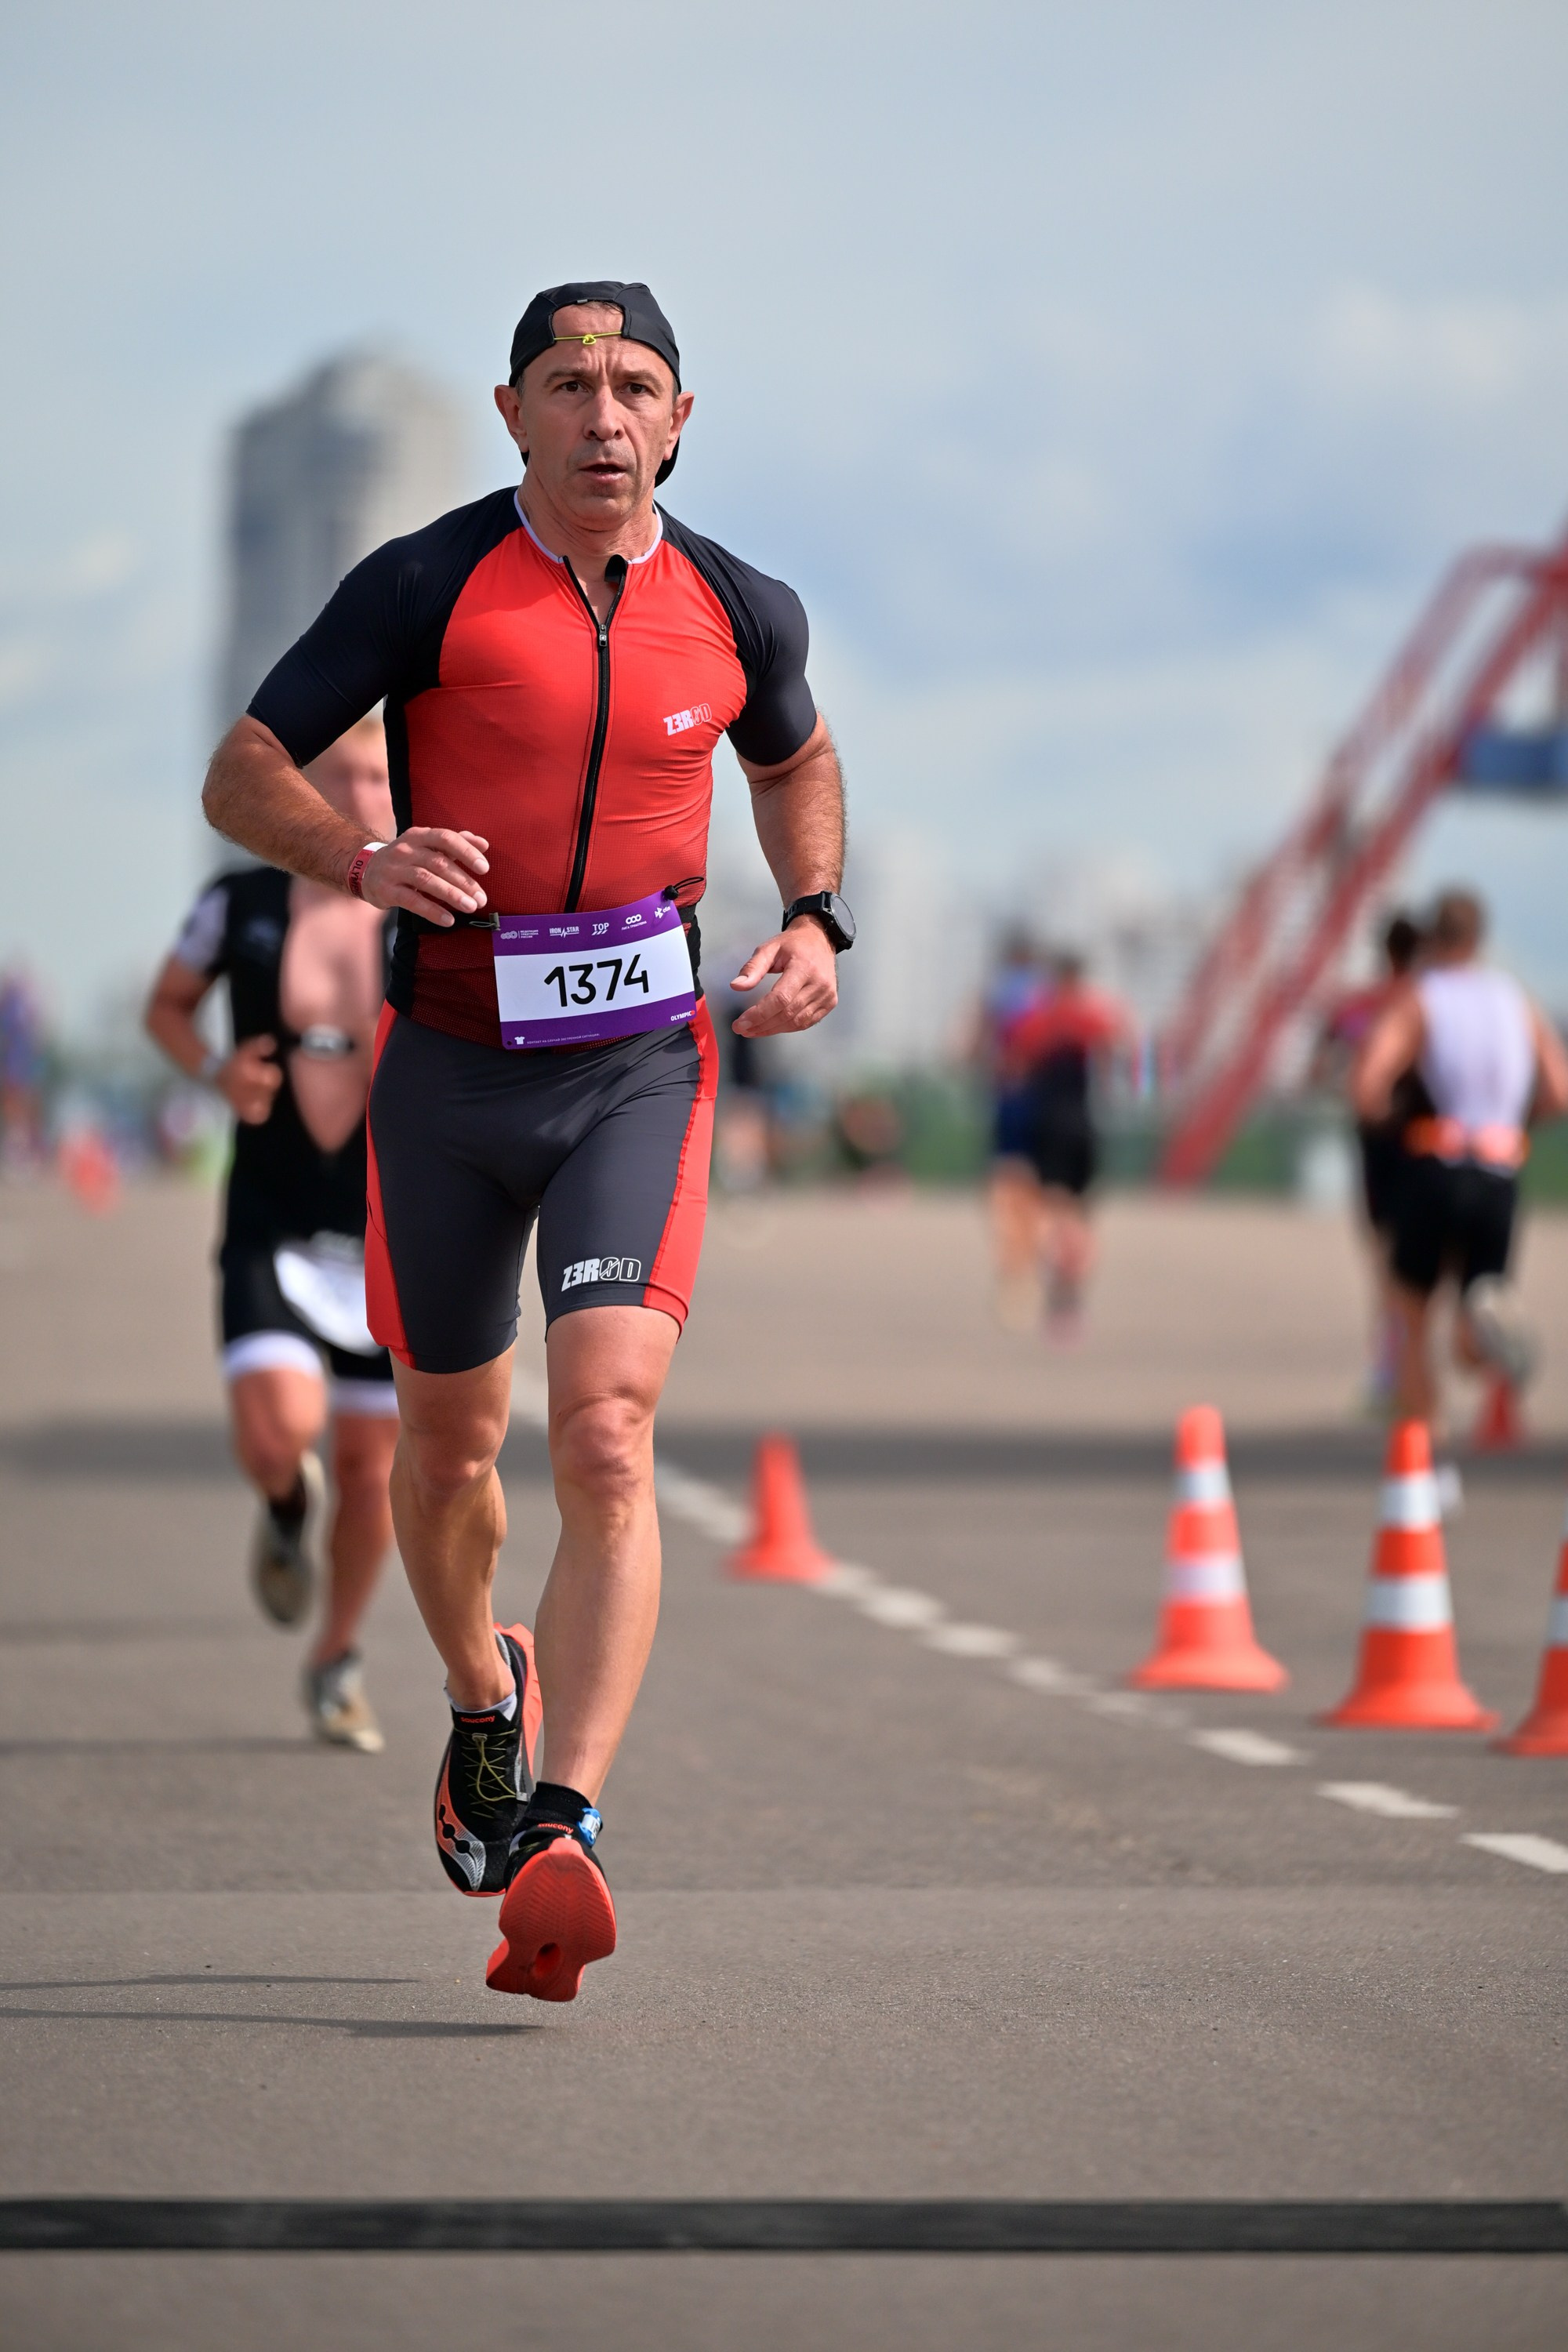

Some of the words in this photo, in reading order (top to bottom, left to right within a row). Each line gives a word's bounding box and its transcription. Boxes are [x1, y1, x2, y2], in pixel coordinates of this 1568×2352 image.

[592, 922, 609, 931] TOP
[544, 953, 649, 1007] 1374
[670, 1011, 692, 1022] OLYMPIC
[537, 1823, 574, 1835] saucony
